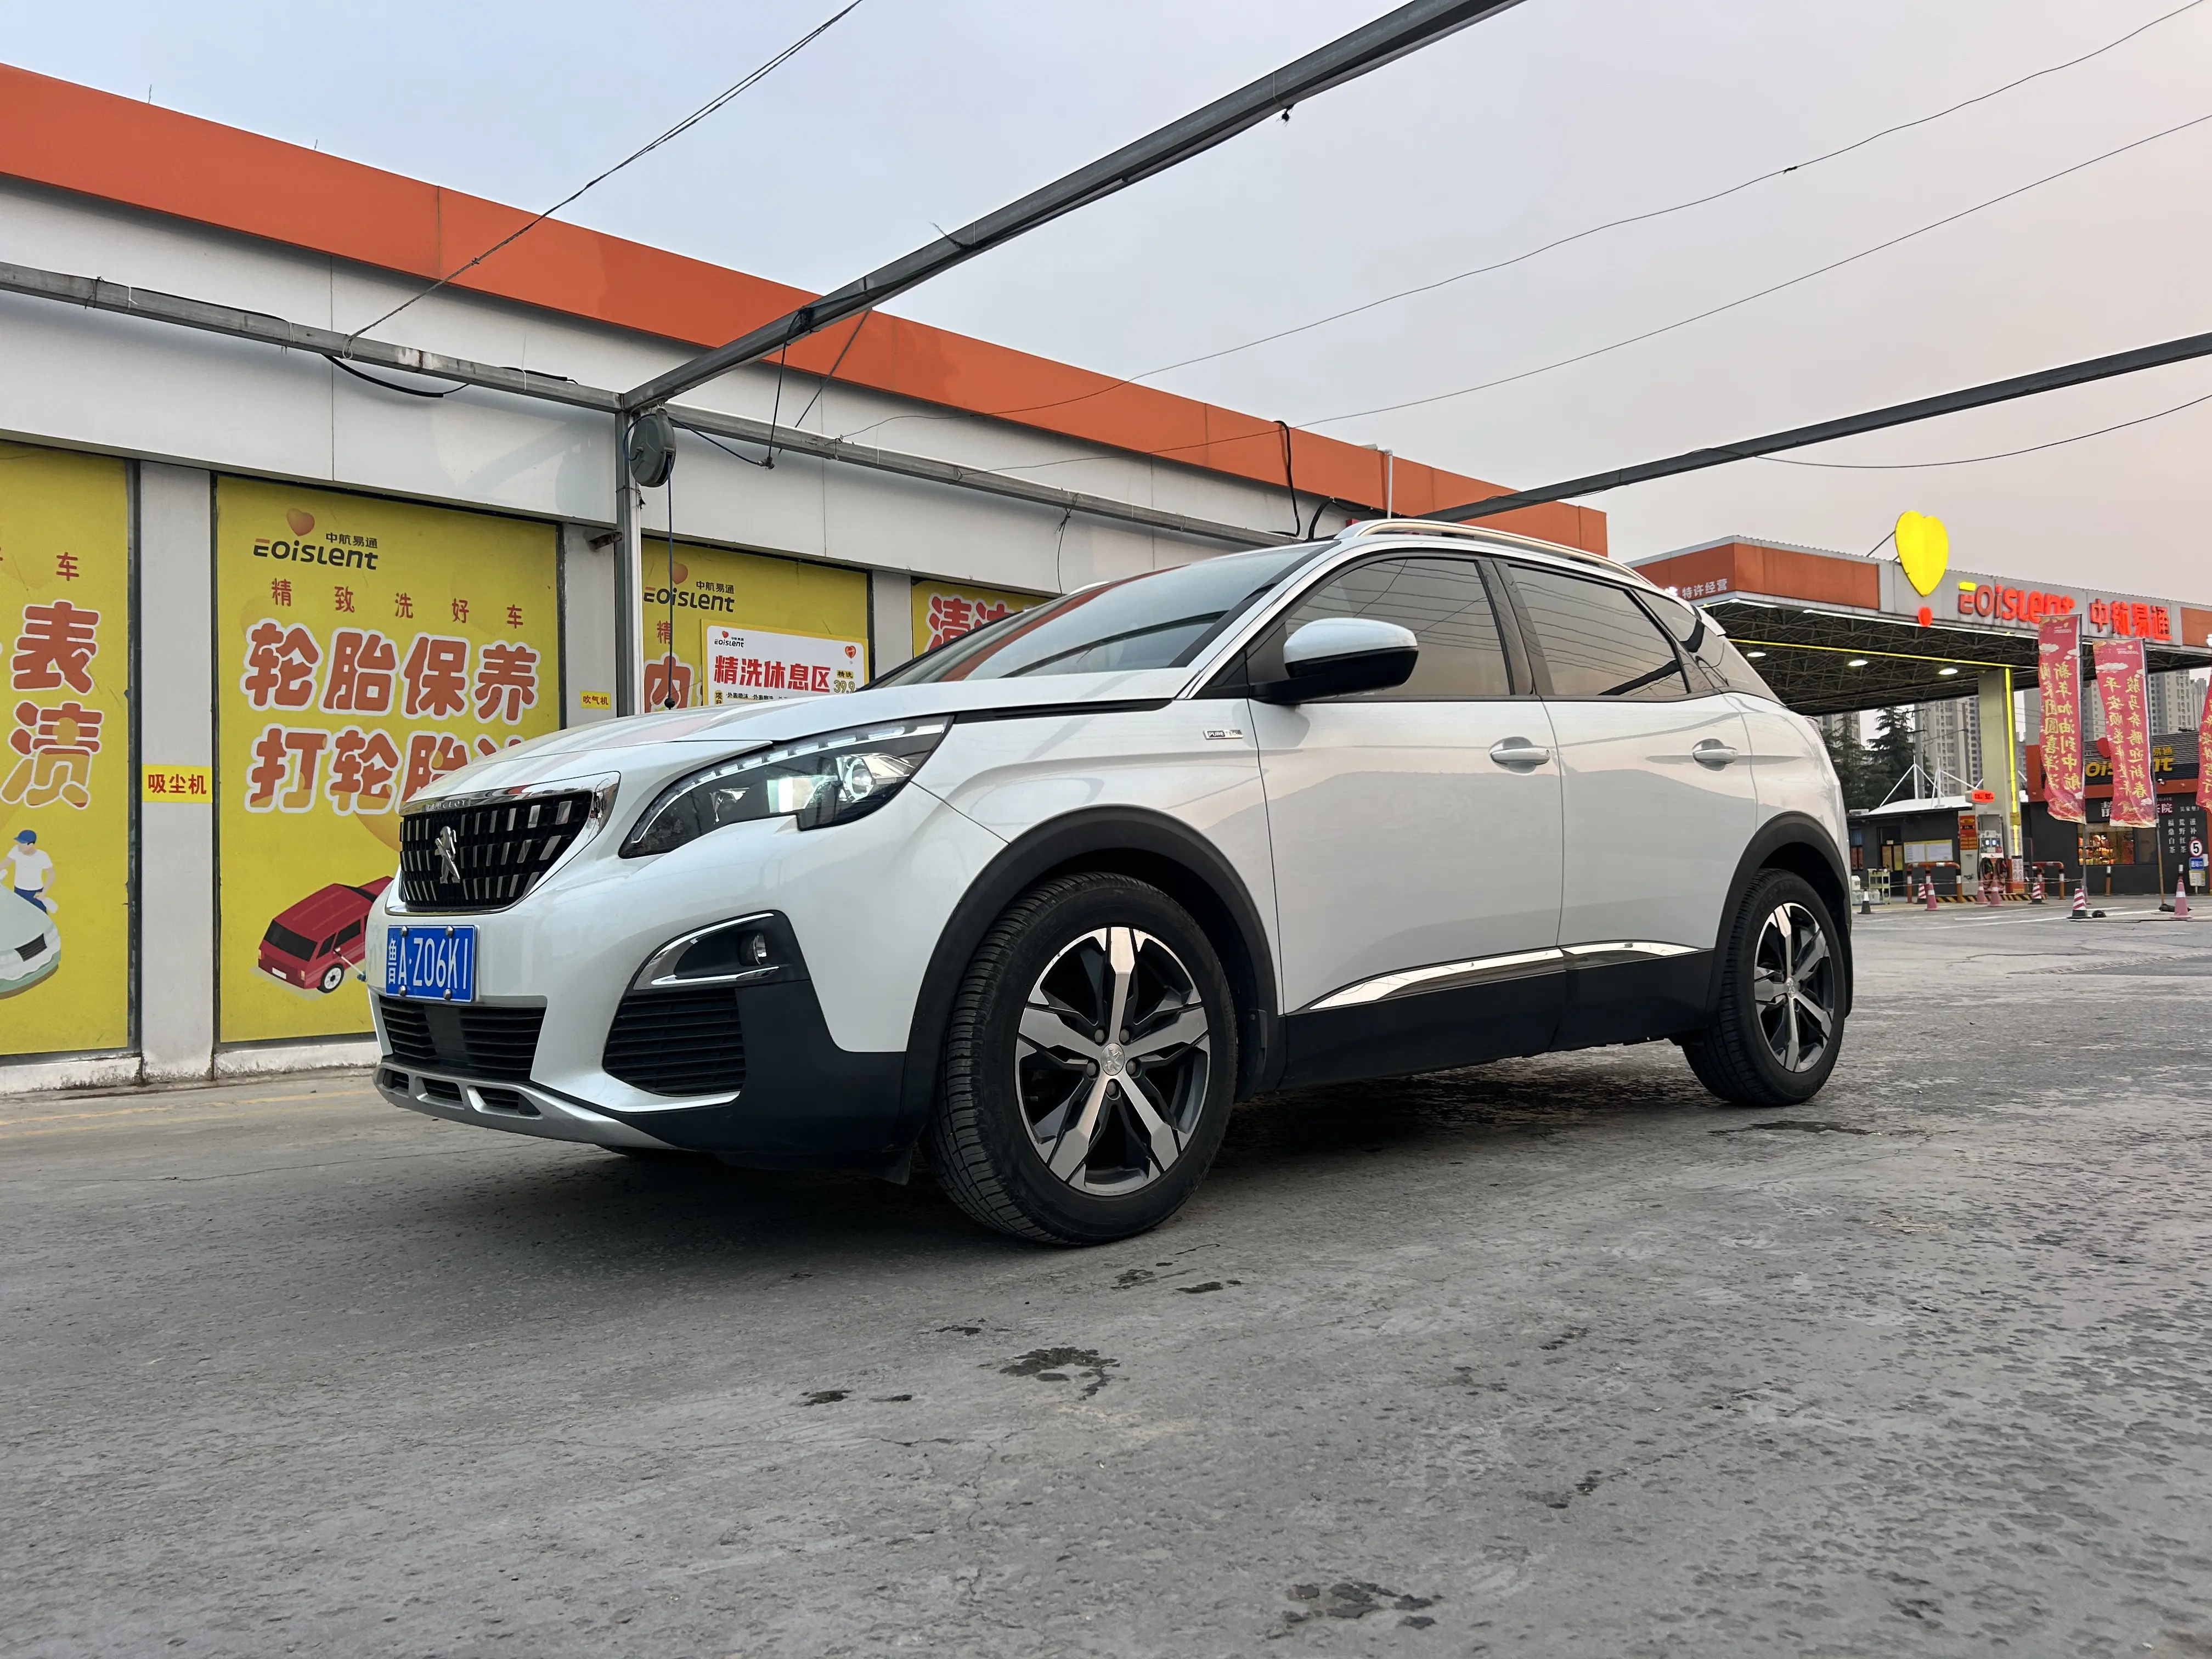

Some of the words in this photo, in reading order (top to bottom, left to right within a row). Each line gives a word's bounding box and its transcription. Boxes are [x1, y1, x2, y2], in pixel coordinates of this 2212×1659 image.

[326, 532, 378, 549] 中航易通
[272, 578, 523, 629] 精致洗好车
[696, 580, 735, 594] 中航易通
[1682, 579, 1728, 599] 特许经营
[2090, 599, 2173, 640] 中航易通
[12, 600, 100, 694] 表
[242, 620, 539, 723] 轮胎保养
[644, 653, 693, 713] 内
[714, 655, 831, 693] 精洗休息区
[583, 695, 609, 706] 吹气机
[1, 701, 103, 809] 渍
[148, 774, 207, 795] 吸尘机
[2193, 843, 2199, 854] 5
